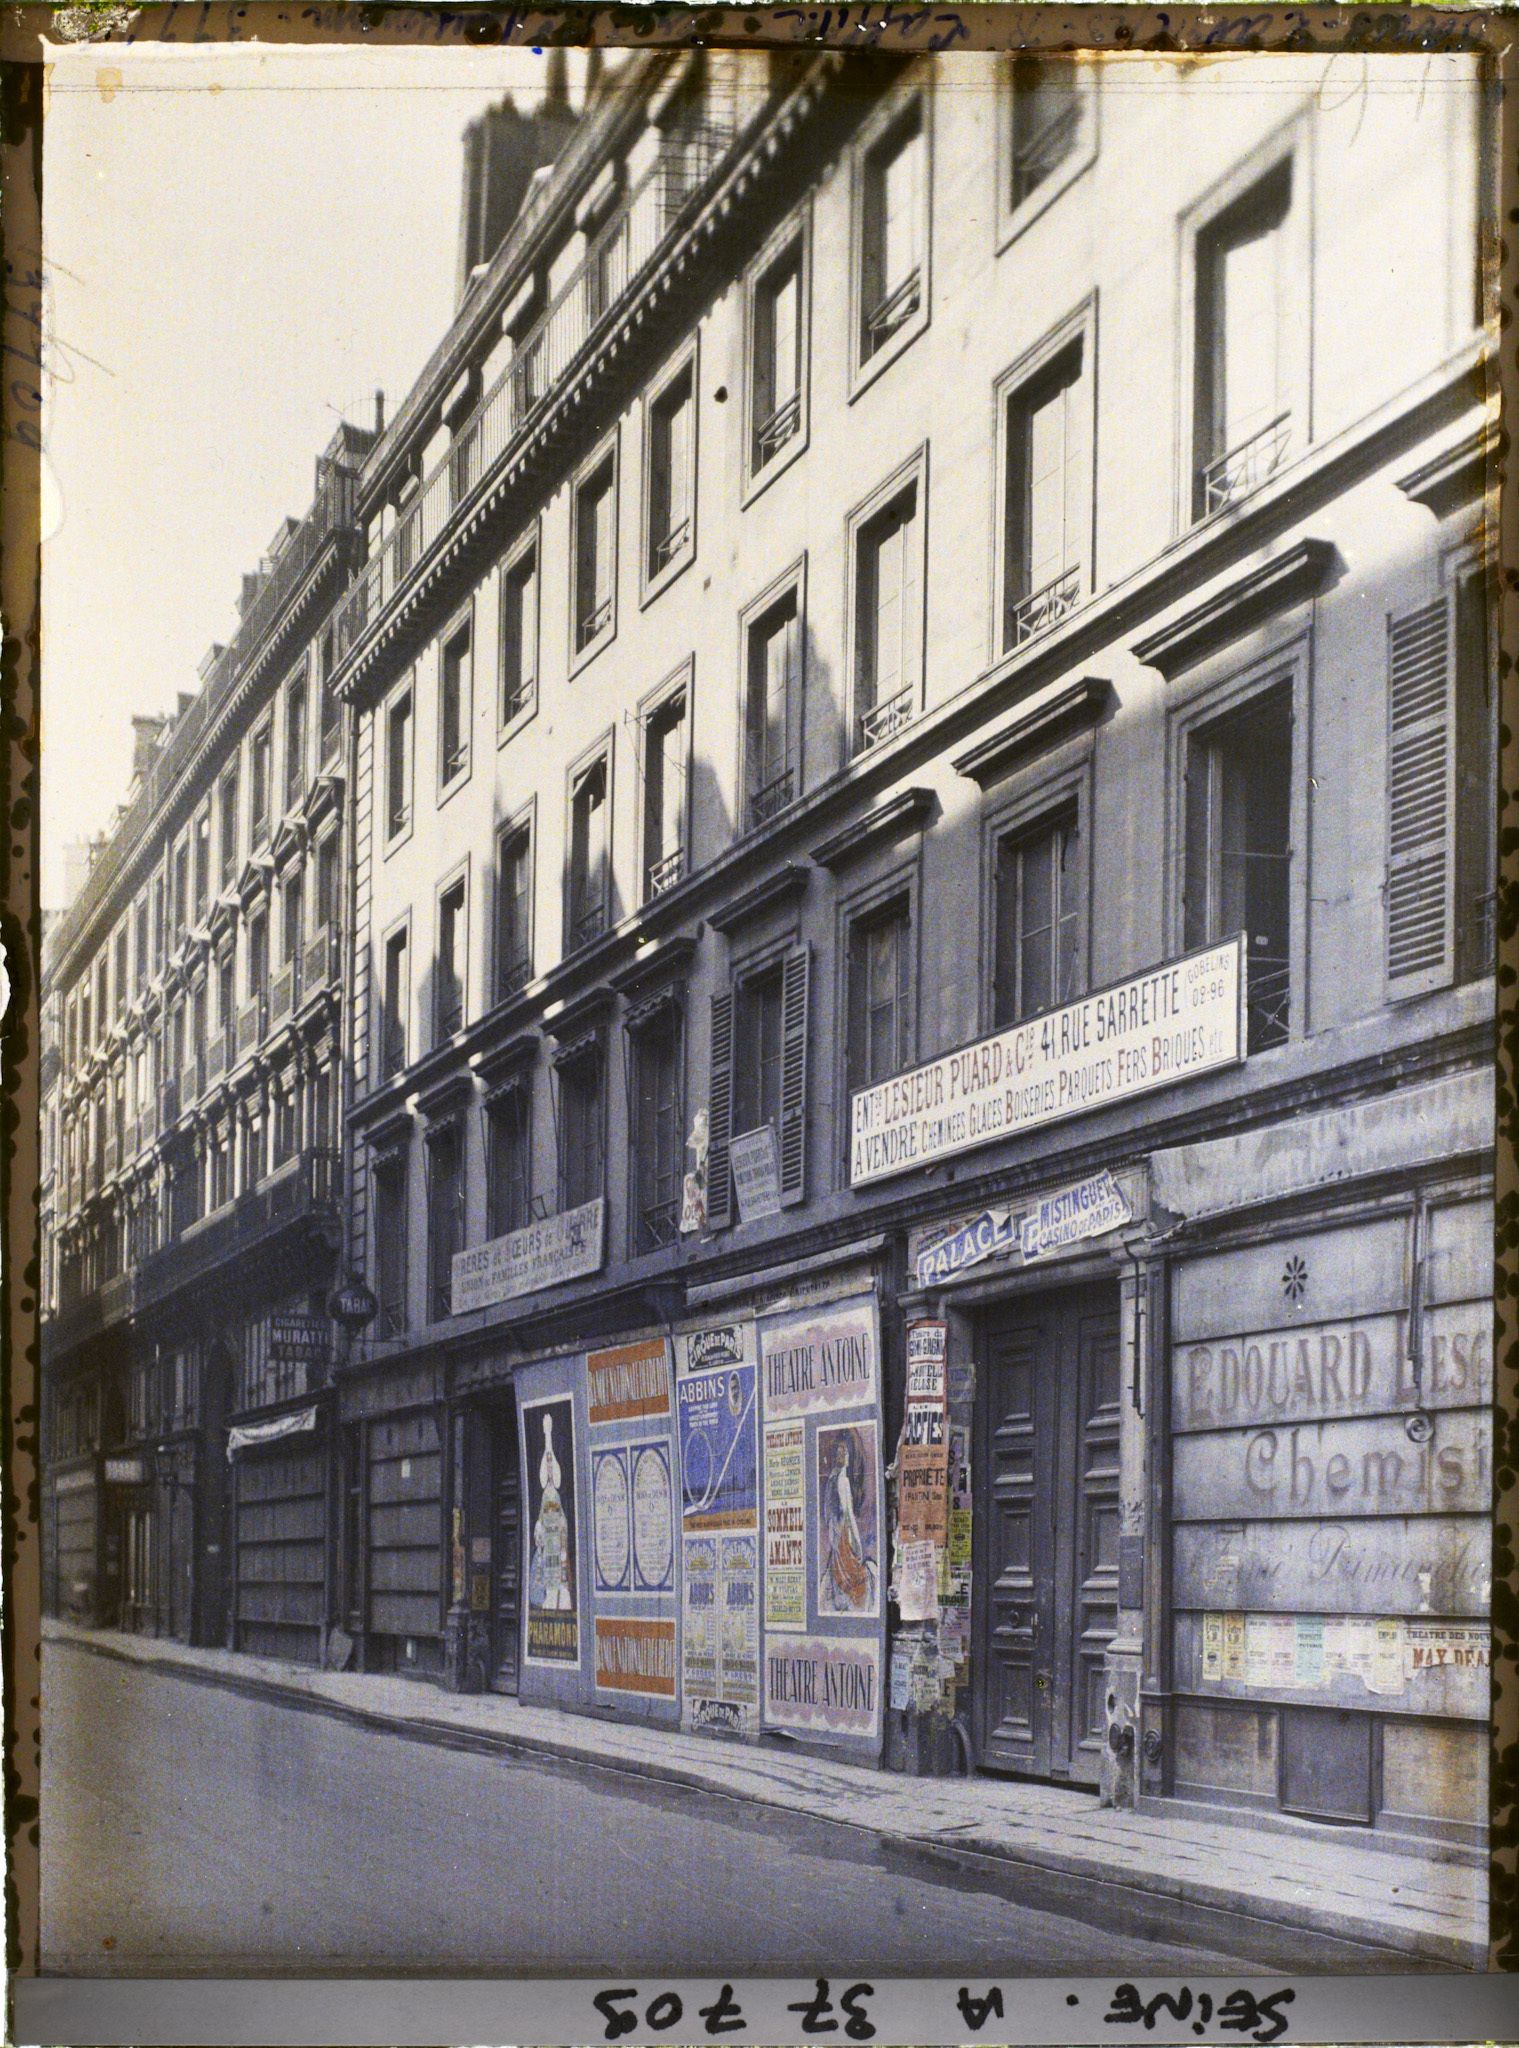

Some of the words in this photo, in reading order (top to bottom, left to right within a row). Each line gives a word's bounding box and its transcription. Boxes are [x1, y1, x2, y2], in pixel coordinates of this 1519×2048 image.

[885, 1065, 944, 1124] LESIEUR
[950, 1041, 1001, 1099] PUARD
[1061, 1004, 1090, 1055] RUE
[1097, 970, 1179, 1042] SARRETTE
[865, 1122, 917, 1172] VENDRE
[969, 1097, 1002, 1138] GLACES
[1059, 1058, 1112, 1107] PARQUETS
[1118, 1048, 1147, 1087] FERS
[1151, 1025, 1204, 1077] BRIQUES
[1040, 1219, 1077, 1249] CASINO
[1089, 1201, 1121, 1229] PARIS
[923, 1221, 1008, 1286] PALACE
[340, 1297, 370, 1314] TABA
[766, 1345, 815, 1397] THEATRE
[820, 1333, 869, 1386] ANTOINE
[1187, 1330, 1373, 1422] EDOUARD
[680, 1376, 725, 1404] ABBINS
[903, 1467, 945, 1488] PROPRIETE
[767, 1506, 803, 1533] SOMMEIL
[769, 1540, 802, 1565] AMANTS
[1407, 1631, 1445, 1641] THEATRE
[1449, 1631, 1466, 1641] DES
[1412, 1648, 1448, 1669] MAY
[768, 1657, 817, 1704] THEATRE
[821, 1661, 874, 1711] ANTOINE
[956, 1984, 1004, 2031] A
